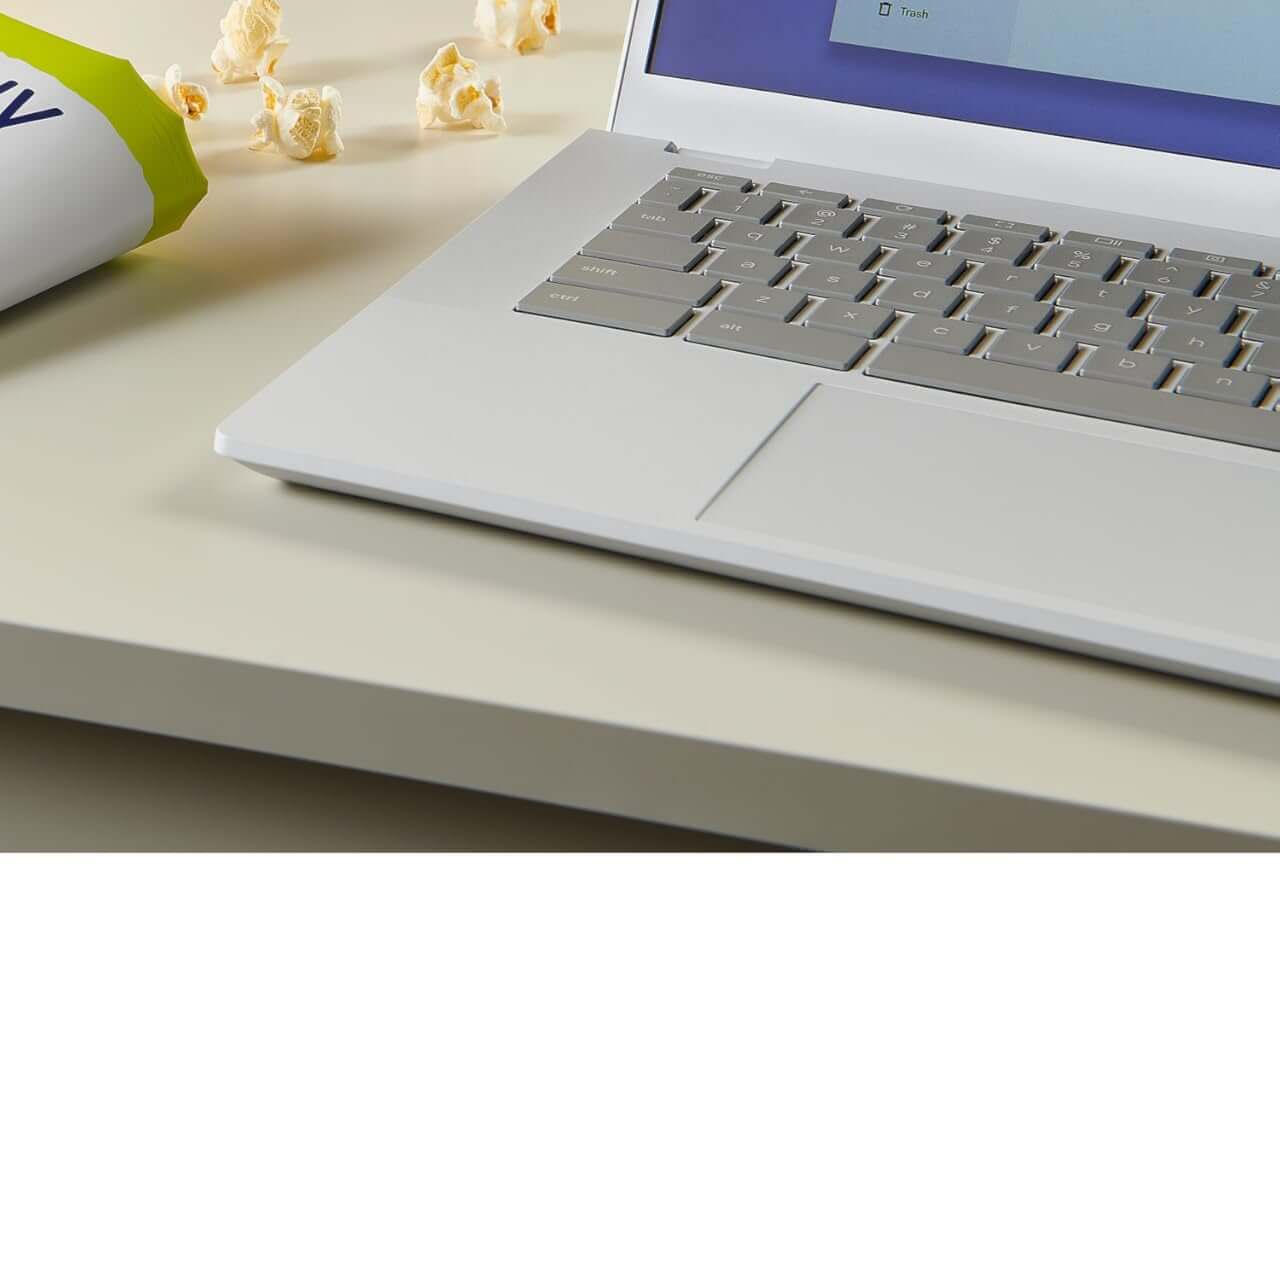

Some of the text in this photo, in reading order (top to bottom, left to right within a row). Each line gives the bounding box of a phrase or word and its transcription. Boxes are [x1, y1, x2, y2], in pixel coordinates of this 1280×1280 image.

[901, 6, 929, 19] Trash
[581, 264, 619, 276] shift
[549, 293, 580, 303] ctrl
[912, 289, 932, 299] d
[720, 323, 744, 333] alt
[1093, 322, 1112, 333] g
